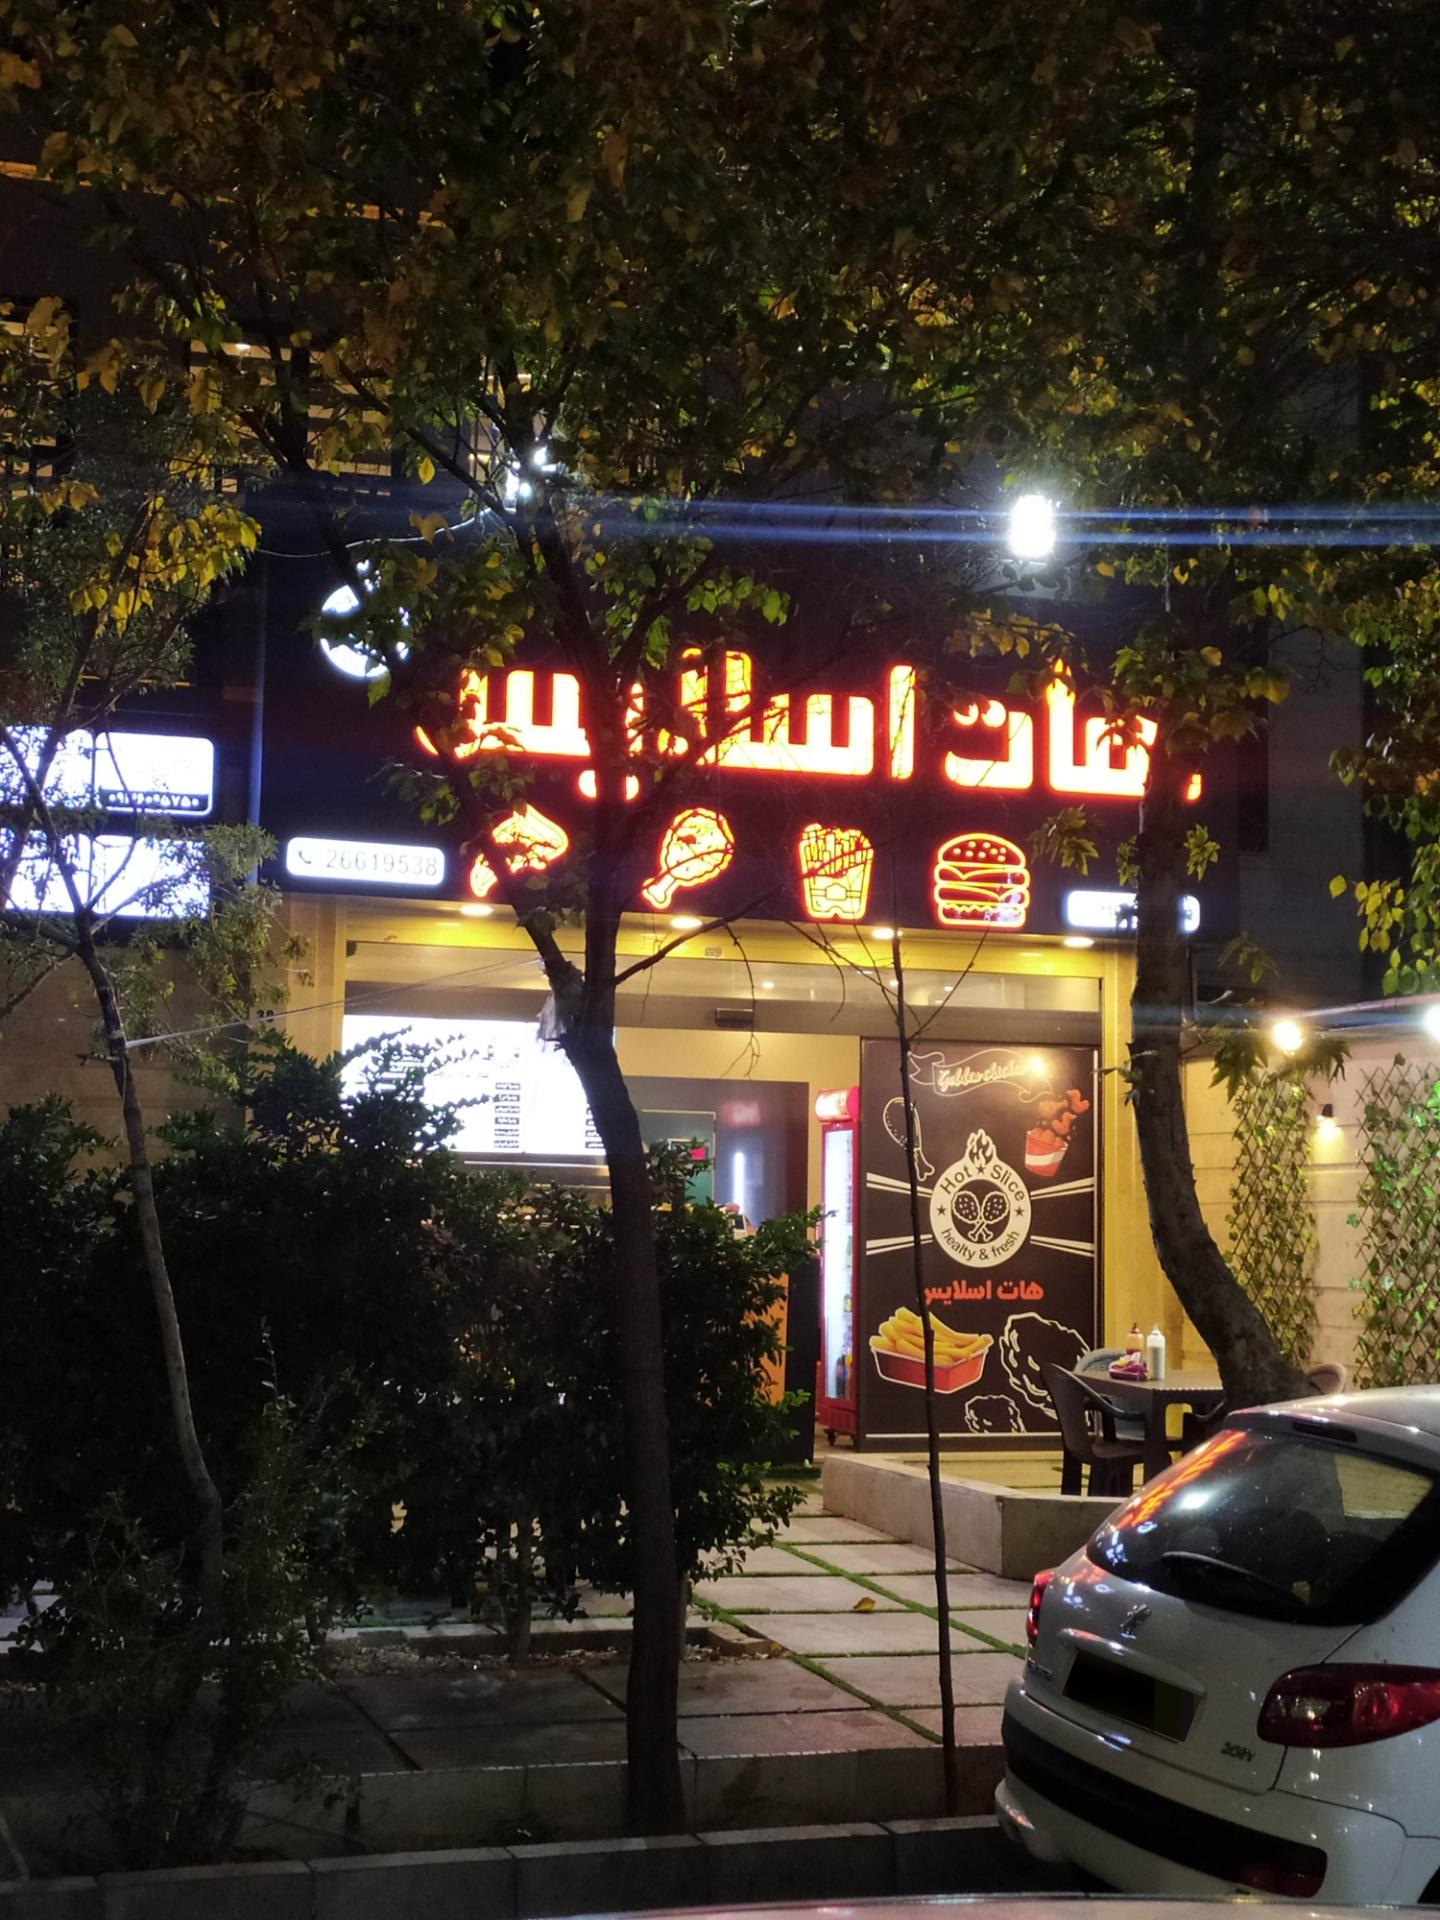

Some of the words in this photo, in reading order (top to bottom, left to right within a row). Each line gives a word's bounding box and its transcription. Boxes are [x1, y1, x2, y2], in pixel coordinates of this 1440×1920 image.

[325, 849, 438, 877] 26619538
[940, 1165, 973, 1195] Hot
[990, 1164, 1025, 1201] Slice
[941, 1228, 976, 1261] healty
[991, 1231, 1020, 1257] fresh
[997, 1280, 1044, 1300] هات
